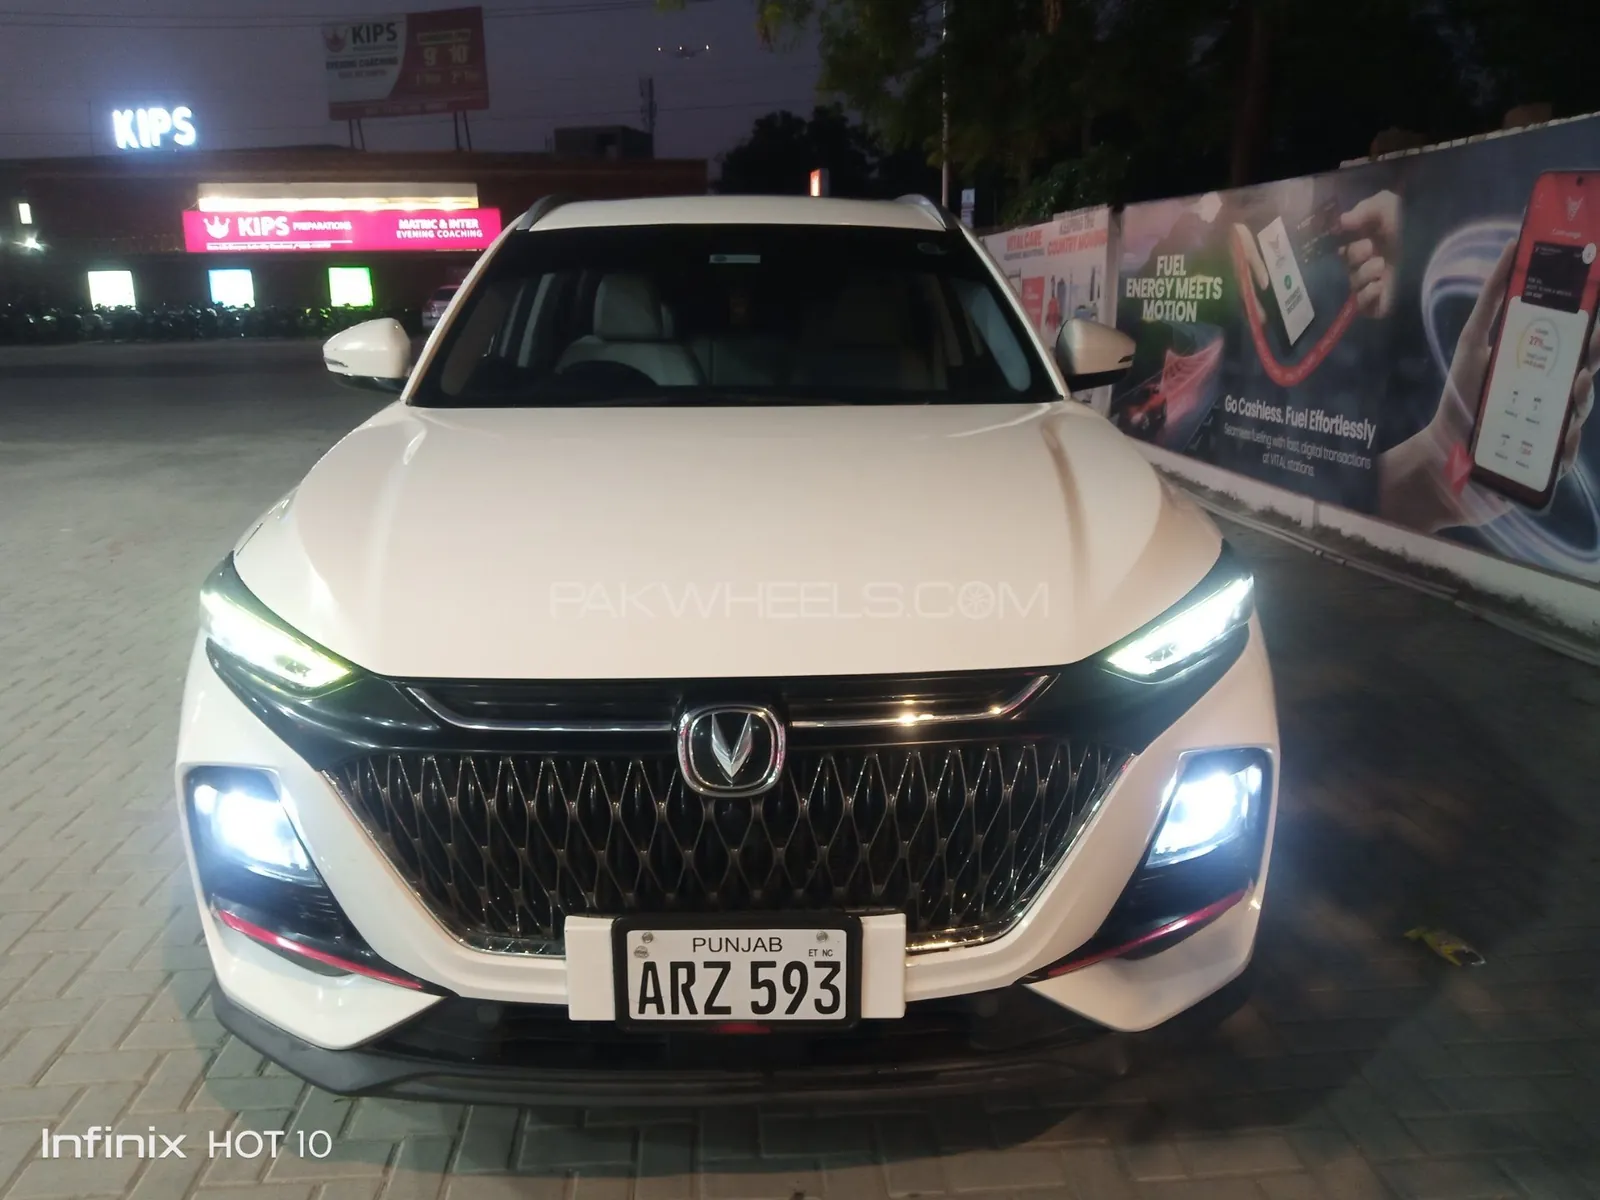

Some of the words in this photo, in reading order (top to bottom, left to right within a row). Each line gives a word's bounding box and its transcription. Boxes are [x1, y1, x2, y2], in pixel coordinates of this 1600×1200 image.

[352, 23, 398, 45] KIPS
[112, 106, 197, 149] KIPS
[238, 216, 290, 236] KIPS
[396, 230, 434, 239] EVENING
[437, 230, 483, 238] COACHING
[399, 219, 438, 229] MATRIC
[449, 219, 479, 229] INTER
[1157, 254, 1187, 276] FUEL
[1126, 278, 1175, 298] ENERGY
[1175, 276, 1223, 299] MEETS
[1142, 300, 1197, 322] MOTION
[1224, 395, 1238, 414] Go
[1238, 397, 1284, 424] Cashless.
[1285, 406, 1309, 429] Fuel
[1309, 409, 1376, 449] Effortlessly
[1272, 434, 1286, 450] with
[1301, 441, 1323, 460] digital
[1323, 446, 1371, 470] transactions
[692, 936, 783, 953] PUNJAB
[808, 949, 818, 957] ET
[822, 949, 833, 957] NC
[638, 961, 732, 1015] ARZ
[750, 961, 841, 1015] 593
